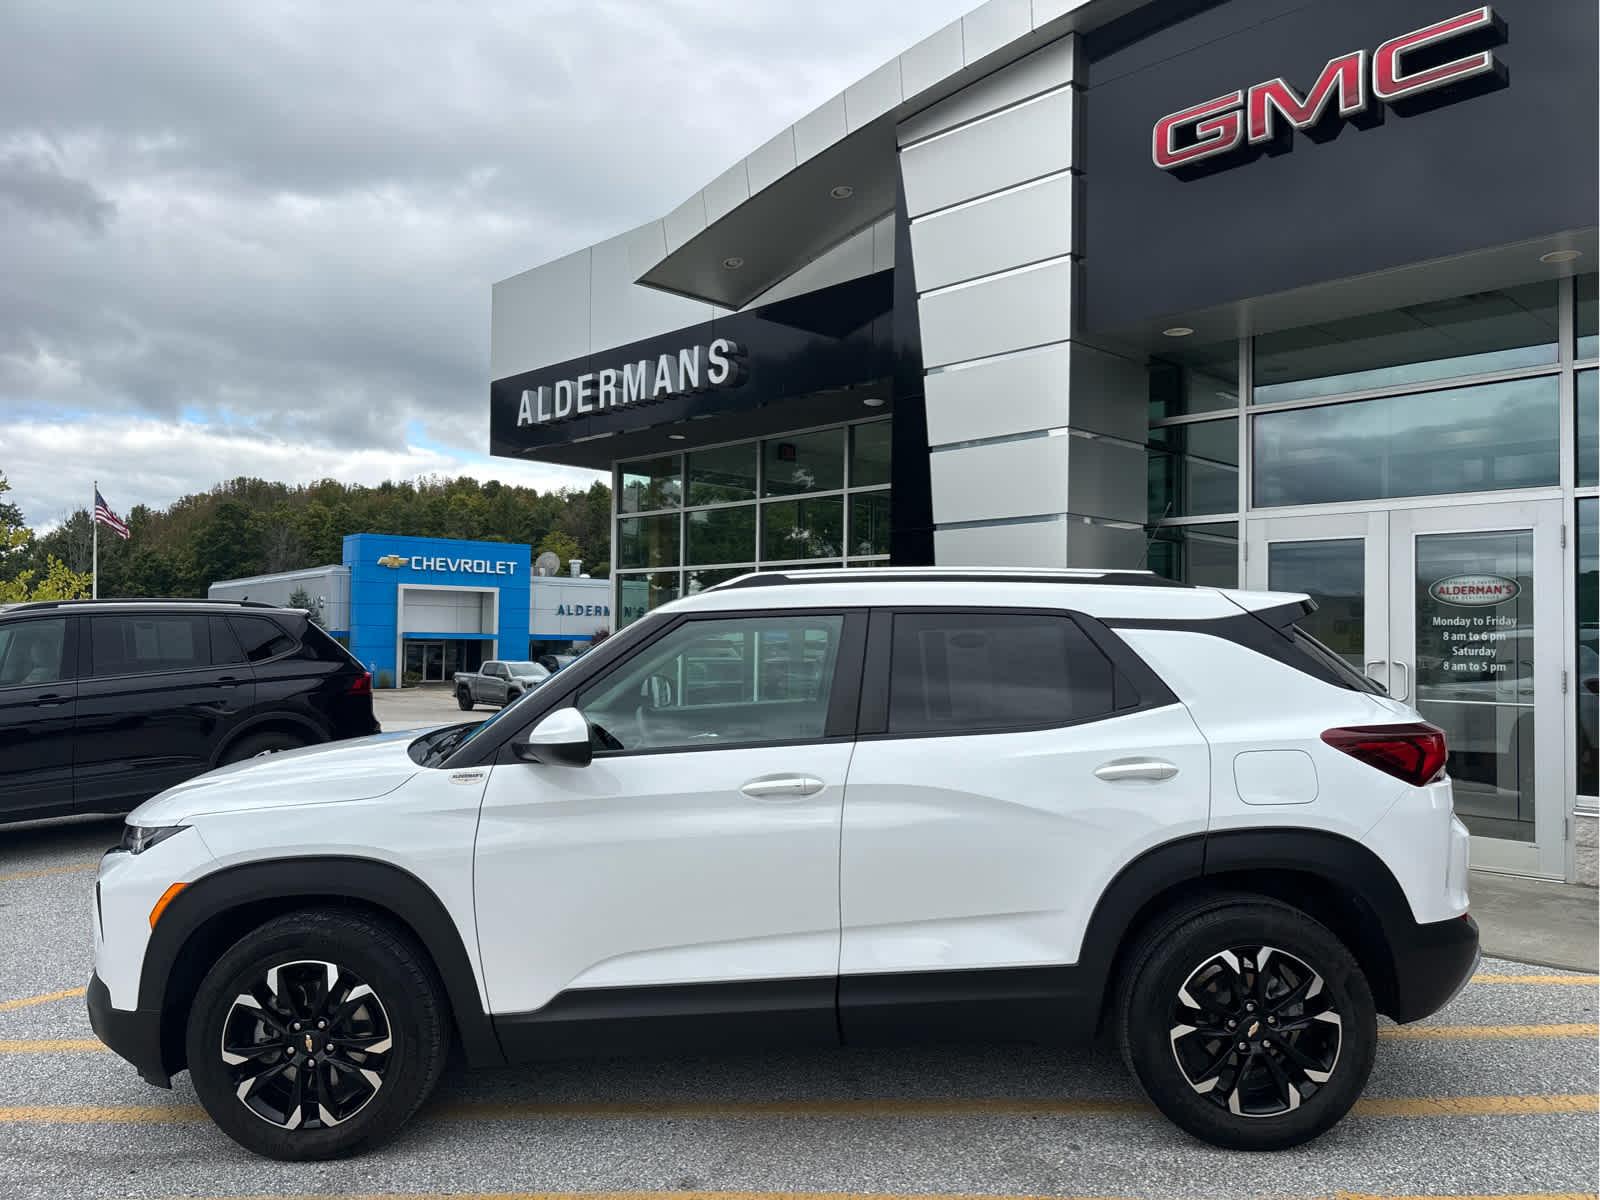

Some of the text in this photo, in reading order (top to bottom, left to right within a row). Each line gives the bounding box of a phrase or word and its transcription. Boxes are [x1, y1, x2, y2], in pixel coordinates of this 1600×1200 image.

[1152, 4, 1495, 170] GMC
[516, 338, 731, 427] ALDERMANS
[411, 555, 519, 575] CHEVROLET
[1438, 585, 1513, 595] ALDERMAN'S
[557, 604, 645, 618] ALDERMN'S
[1432, 616, 1517, 627] Monday to Friday
[1443, 631, 1506, 642] 8 am to 6 pm
[1452, 646, 1497, 658] Saturday
[1443, 661, 1506, 673] 8 am to 5 pm
